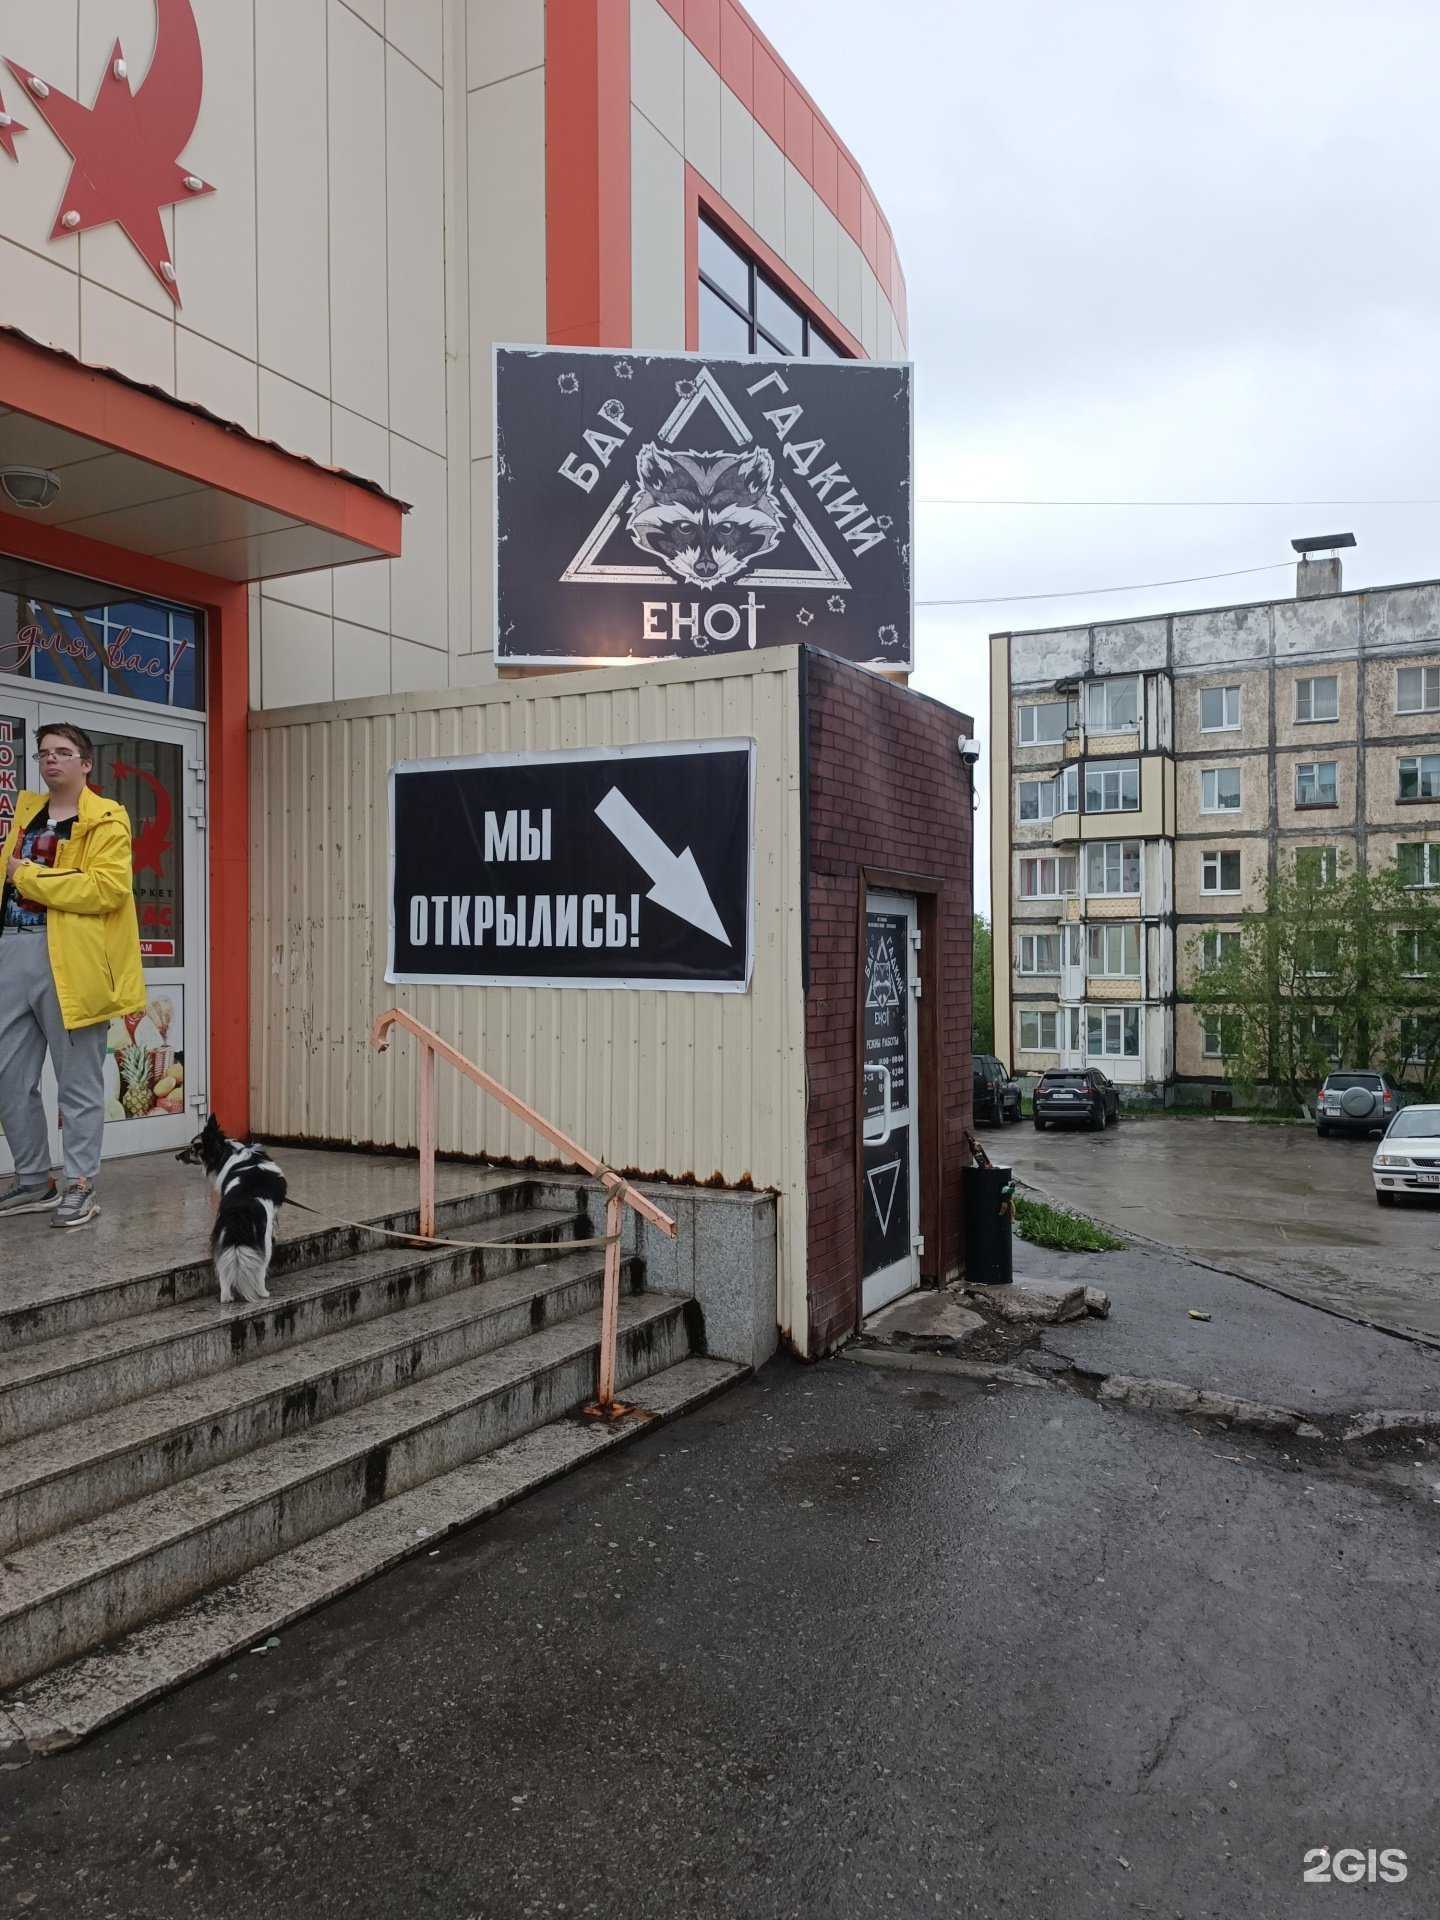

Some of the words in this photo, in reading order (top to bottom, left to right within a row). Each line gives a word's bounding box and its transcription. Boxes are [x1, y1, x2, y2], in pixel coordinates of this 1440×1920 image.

[557, 398, 634, 494] БАР
[746, 370, 893, 558] ГАДКИЙ
[642, 591, 765, 650] ЕНОТ
[106, 626, 187, 683] вас!
[484, 808, 552, 862] МЫ
[409, 893, 640, 949] ОТКРЫЛИСЬ!
